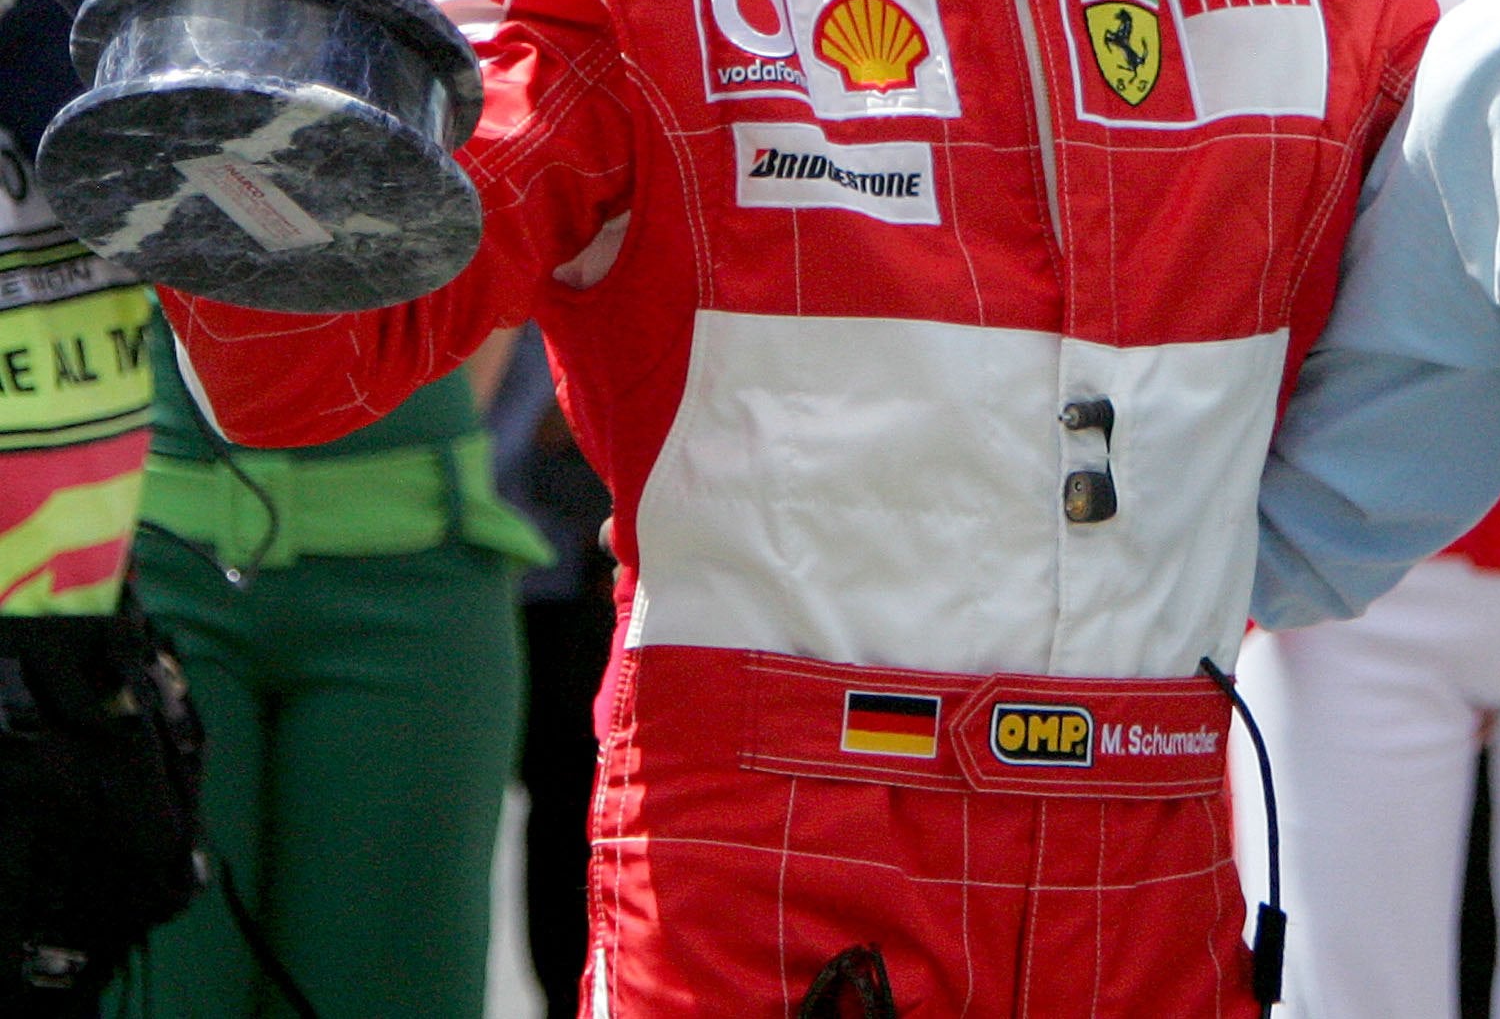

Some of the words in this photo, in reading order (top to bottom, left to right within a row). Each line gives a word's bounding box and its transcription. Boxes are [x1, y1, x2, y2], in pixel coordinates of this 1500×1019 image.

[717, 58, 806, 86] vodafon
[749, 148, 922, 198] BRIDGESTONE
[997, 714, 1087, 753] OMP
